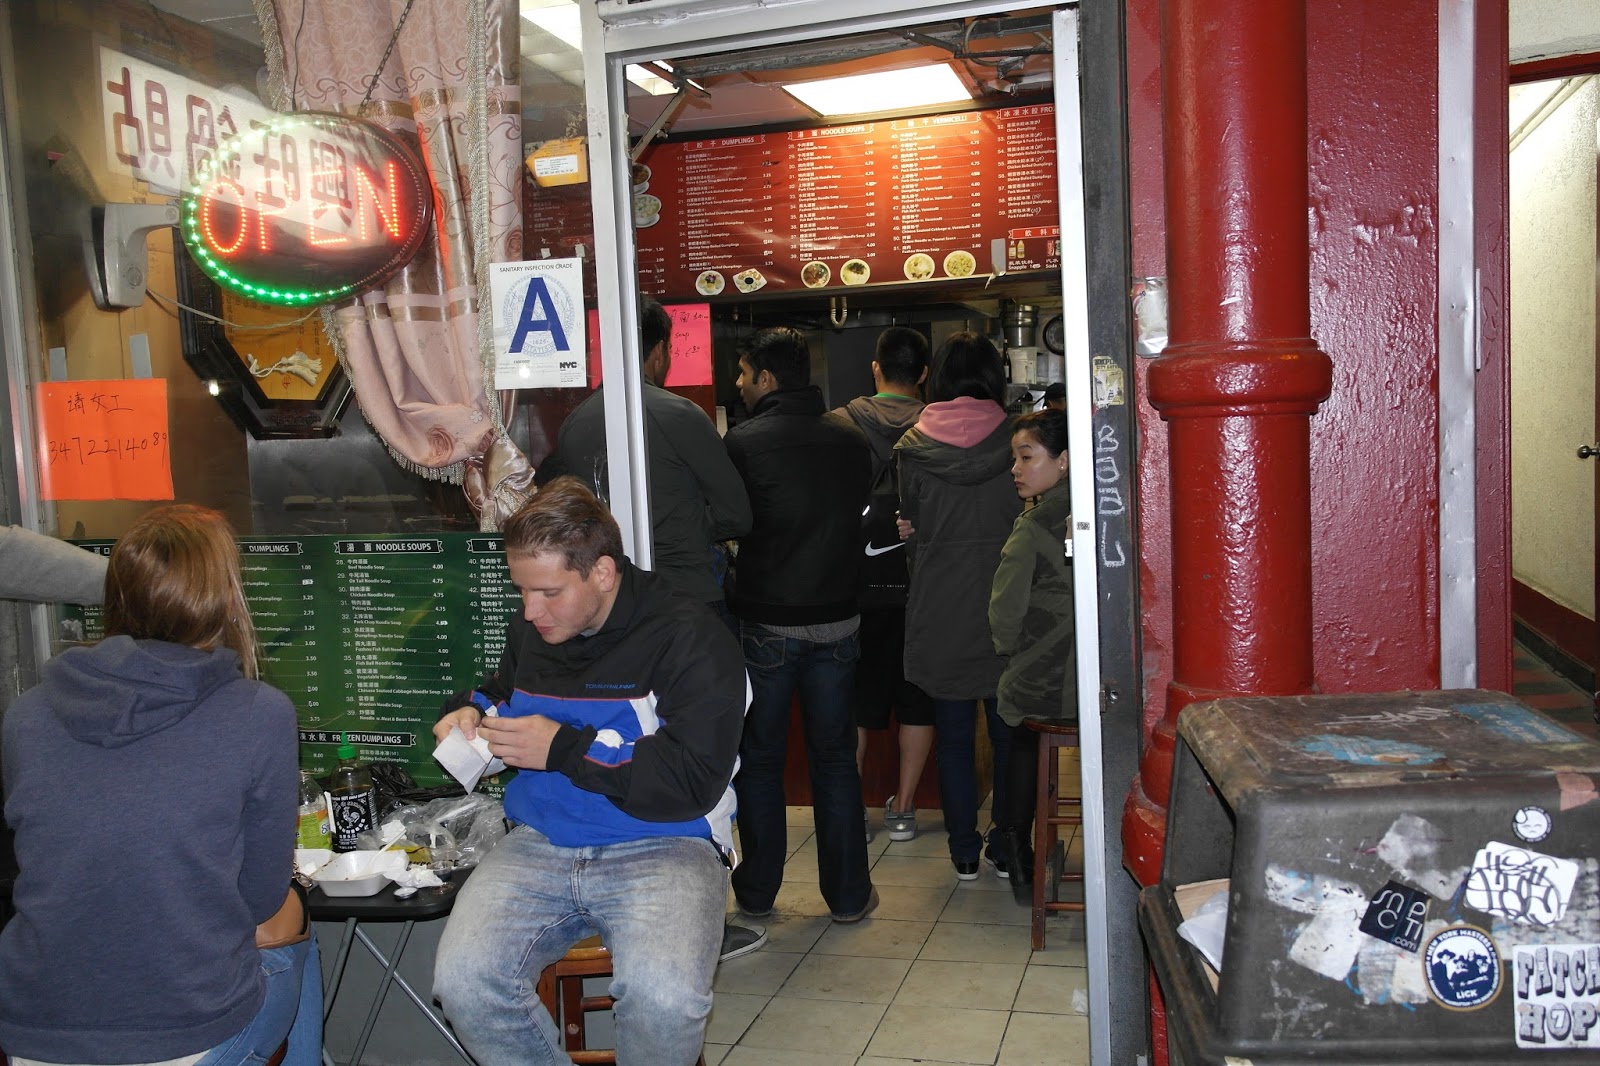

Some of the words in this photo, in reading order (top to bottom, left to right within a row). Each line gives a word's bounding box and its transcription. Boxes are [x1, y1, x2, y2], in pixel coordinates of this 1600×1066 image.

[932, 115, 967, 124] VERMICELLI
[820, 127, 844, 136] NOODLE
[722, 137, 754, 146] DUMPLINGS
[203, 162, 401, 253] OPEN
[508, 277, 570, 353] A
[376, 543, 406, 551] NOODLE
[406, 543, 432, 551] SOUPS
[362, 735, 401, 744] DUMPLINGS
[1437, 930, 1458, 942] YORK
[1460, 930, 1491, 948] MASTERS
